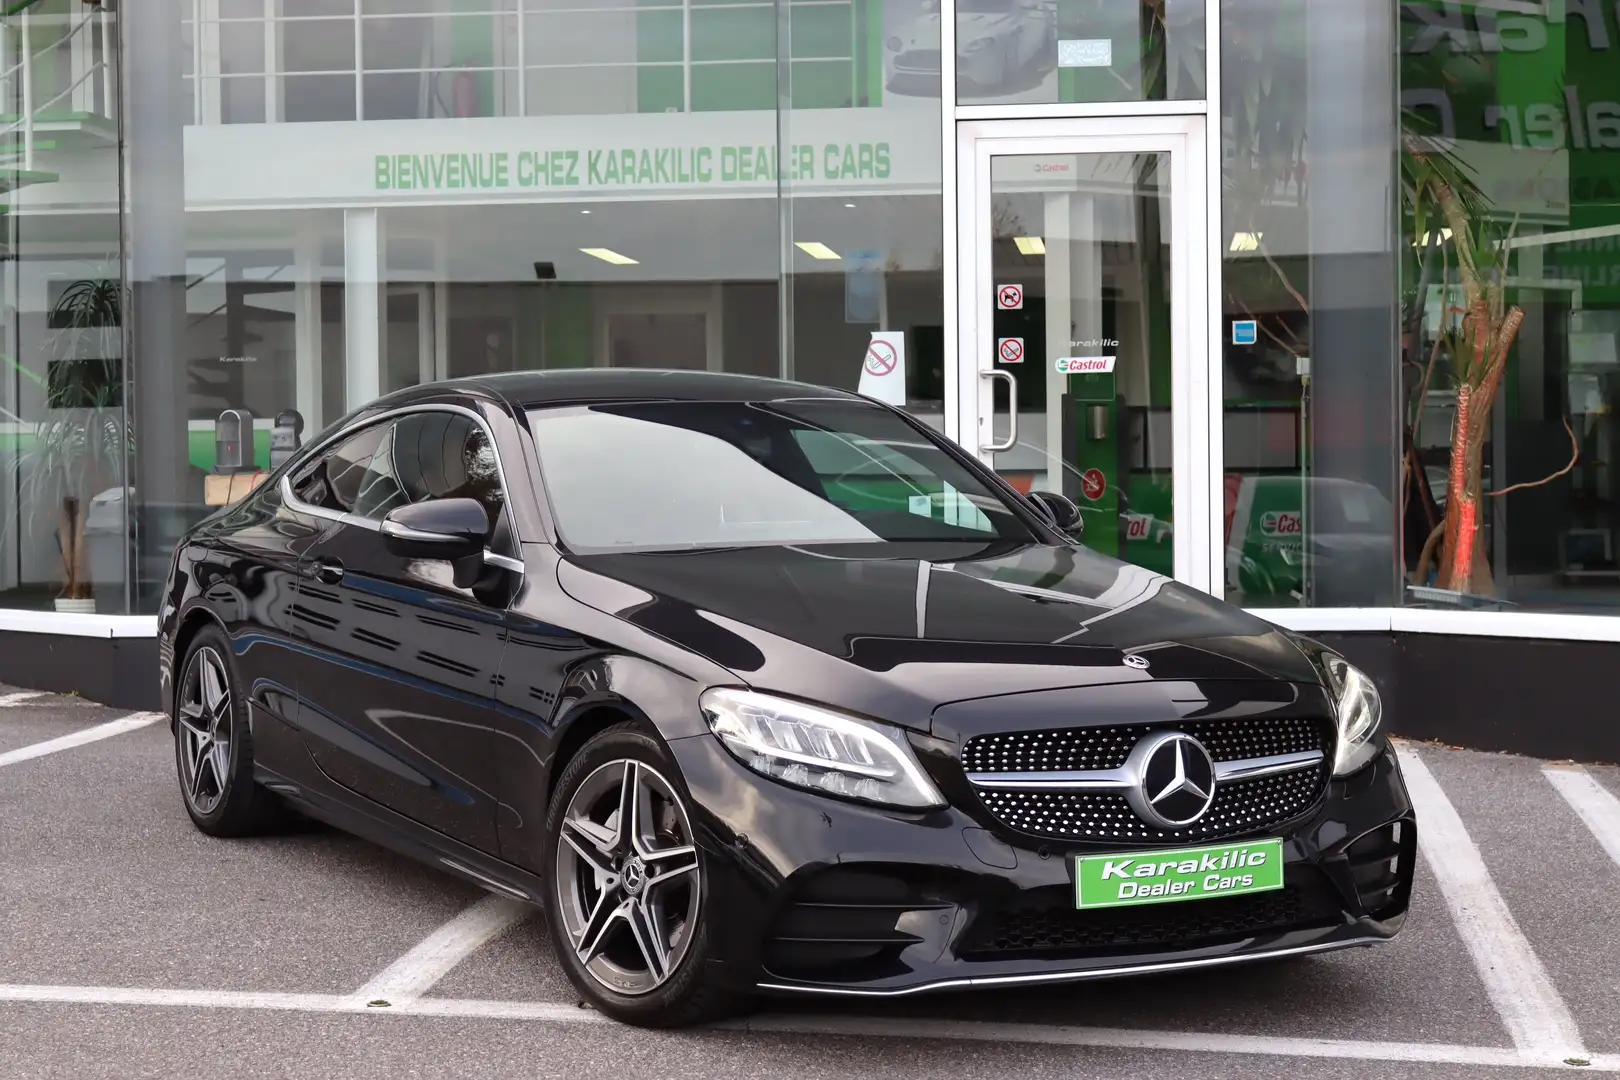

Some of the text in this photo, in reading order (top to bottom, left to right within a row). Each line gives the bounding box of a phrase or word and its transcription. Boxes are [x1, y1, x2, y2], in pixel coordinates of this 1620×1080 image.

[375, 142, 891, 189] BIENVENUE CHEZ KARAKILIC DEALER CARS
[1060, 338, 1119, 348] arakilic
[1069, 359, 1107, 371] Castrol
[1101, 850, 1267, 880] Karakilic
[1118, 874, 1253, 899] Dealer Cars
